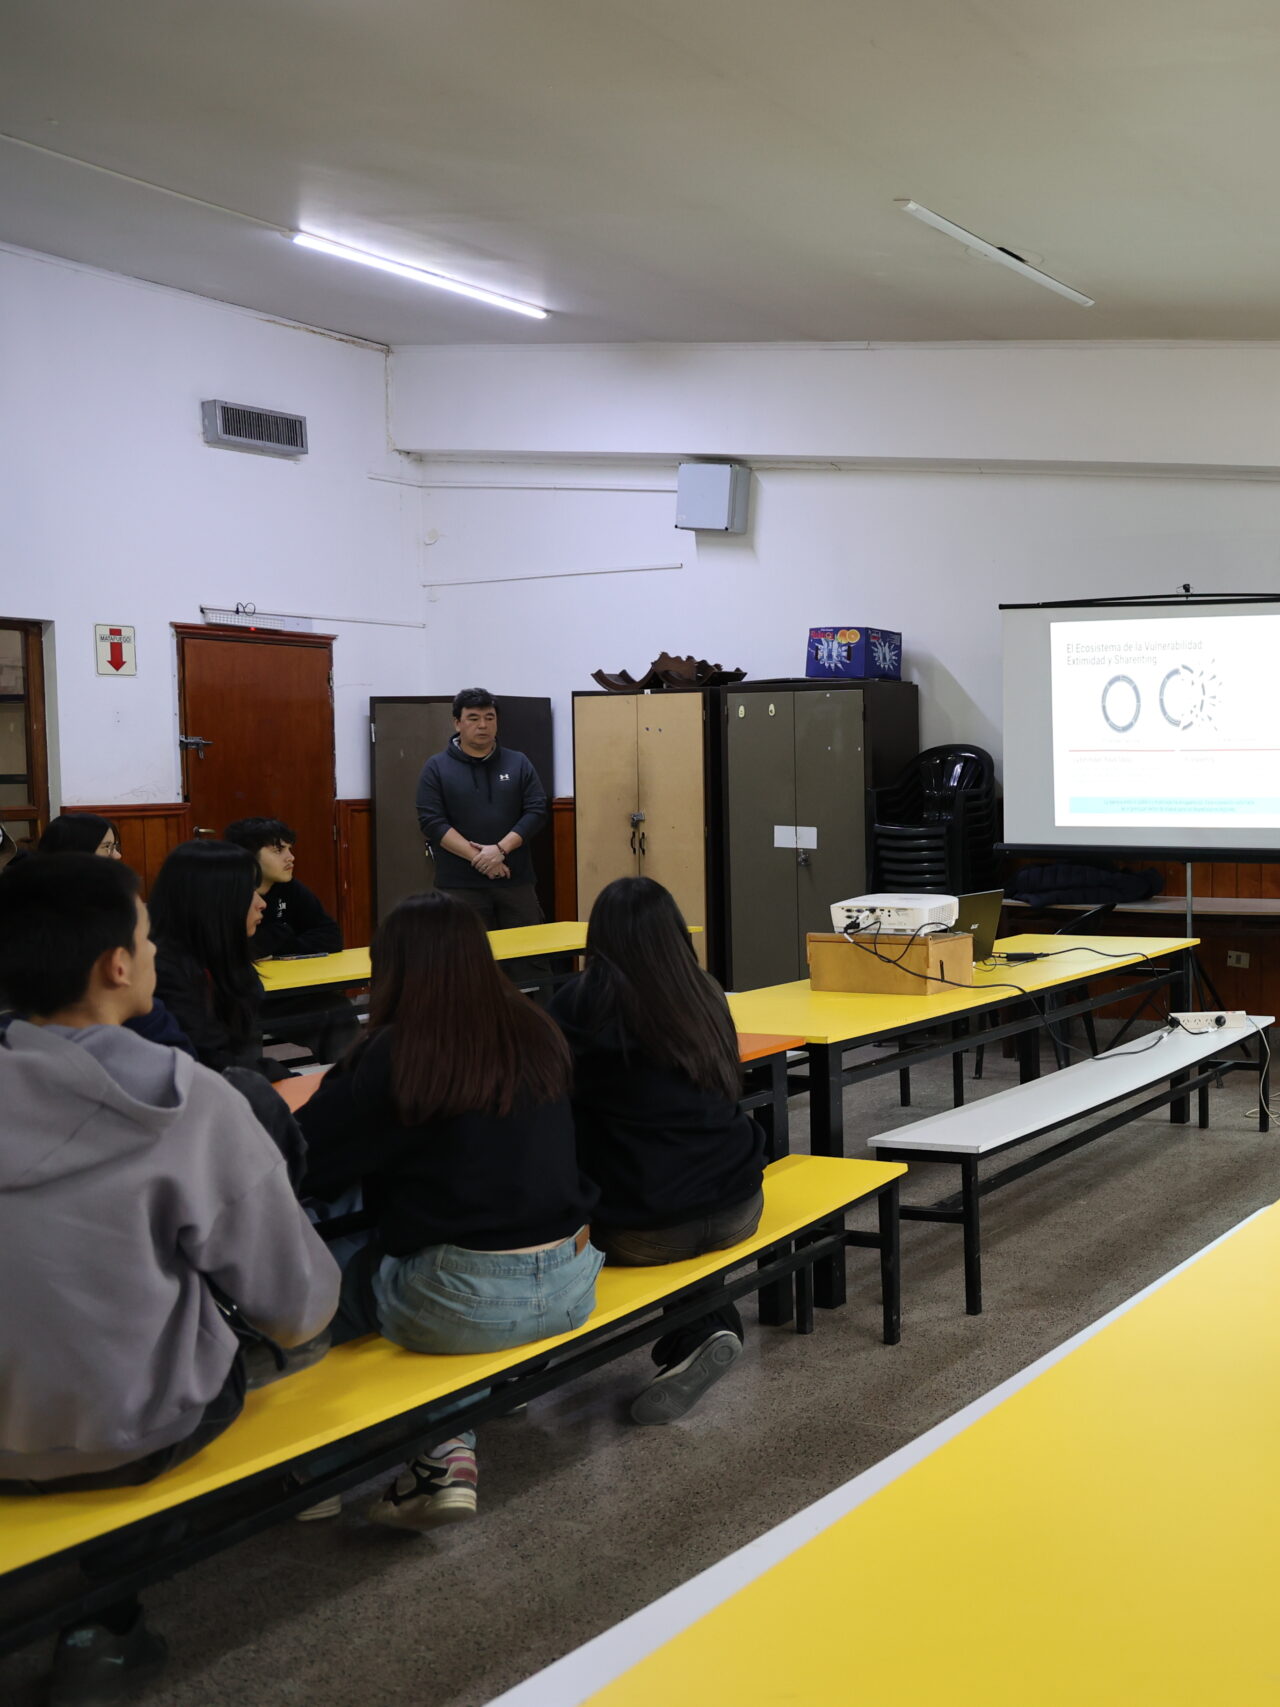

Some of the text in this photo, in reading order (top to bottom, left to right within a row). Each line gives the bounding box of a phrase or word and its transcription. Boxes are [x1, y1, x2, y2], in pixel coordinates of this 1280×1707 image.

[100, 635, 131, 643] MATAFUEGO
[1066, 640, 1203, 653] El Ecosistema de la Vulnerabilidad
[1066, 655, 1106, 666] Extimidad
[1114, 655, 1158, 667] Sharenting
